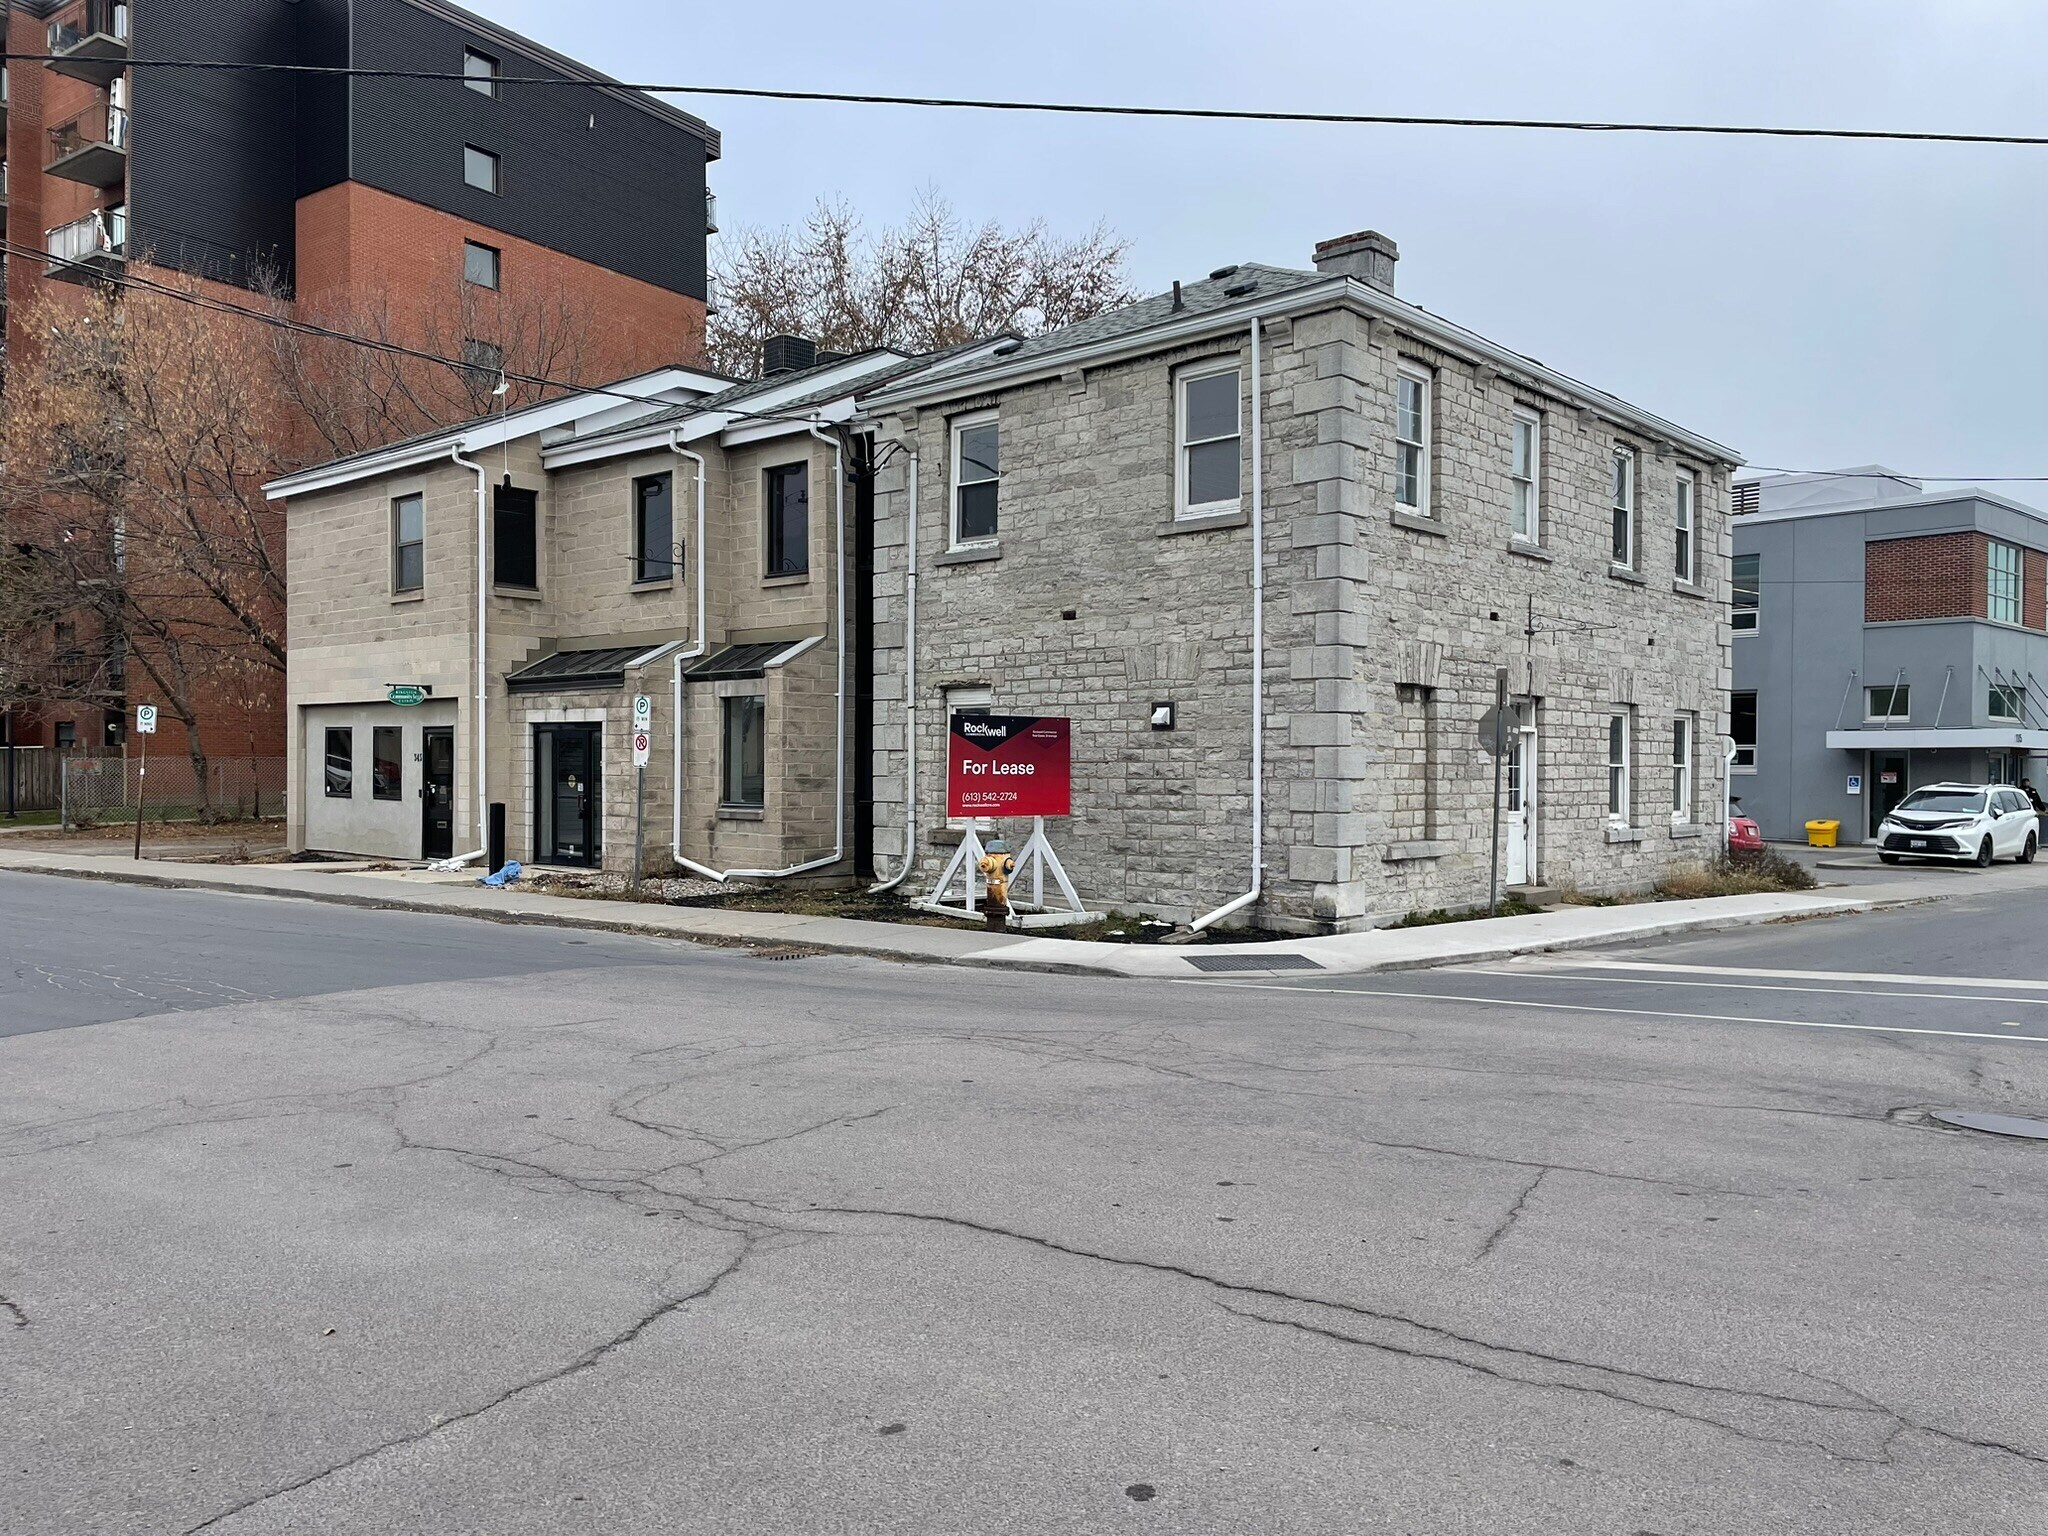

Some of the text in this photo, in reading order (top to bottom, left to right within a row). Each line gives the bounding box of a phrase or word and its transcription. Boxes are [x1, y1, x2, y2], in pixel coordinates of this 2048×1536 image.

[964, 722, 1006, 737] Rockwell
[963, 760, 1035, 775] For Lease
[962, 792, 1017, 803] (613) 542-2724
